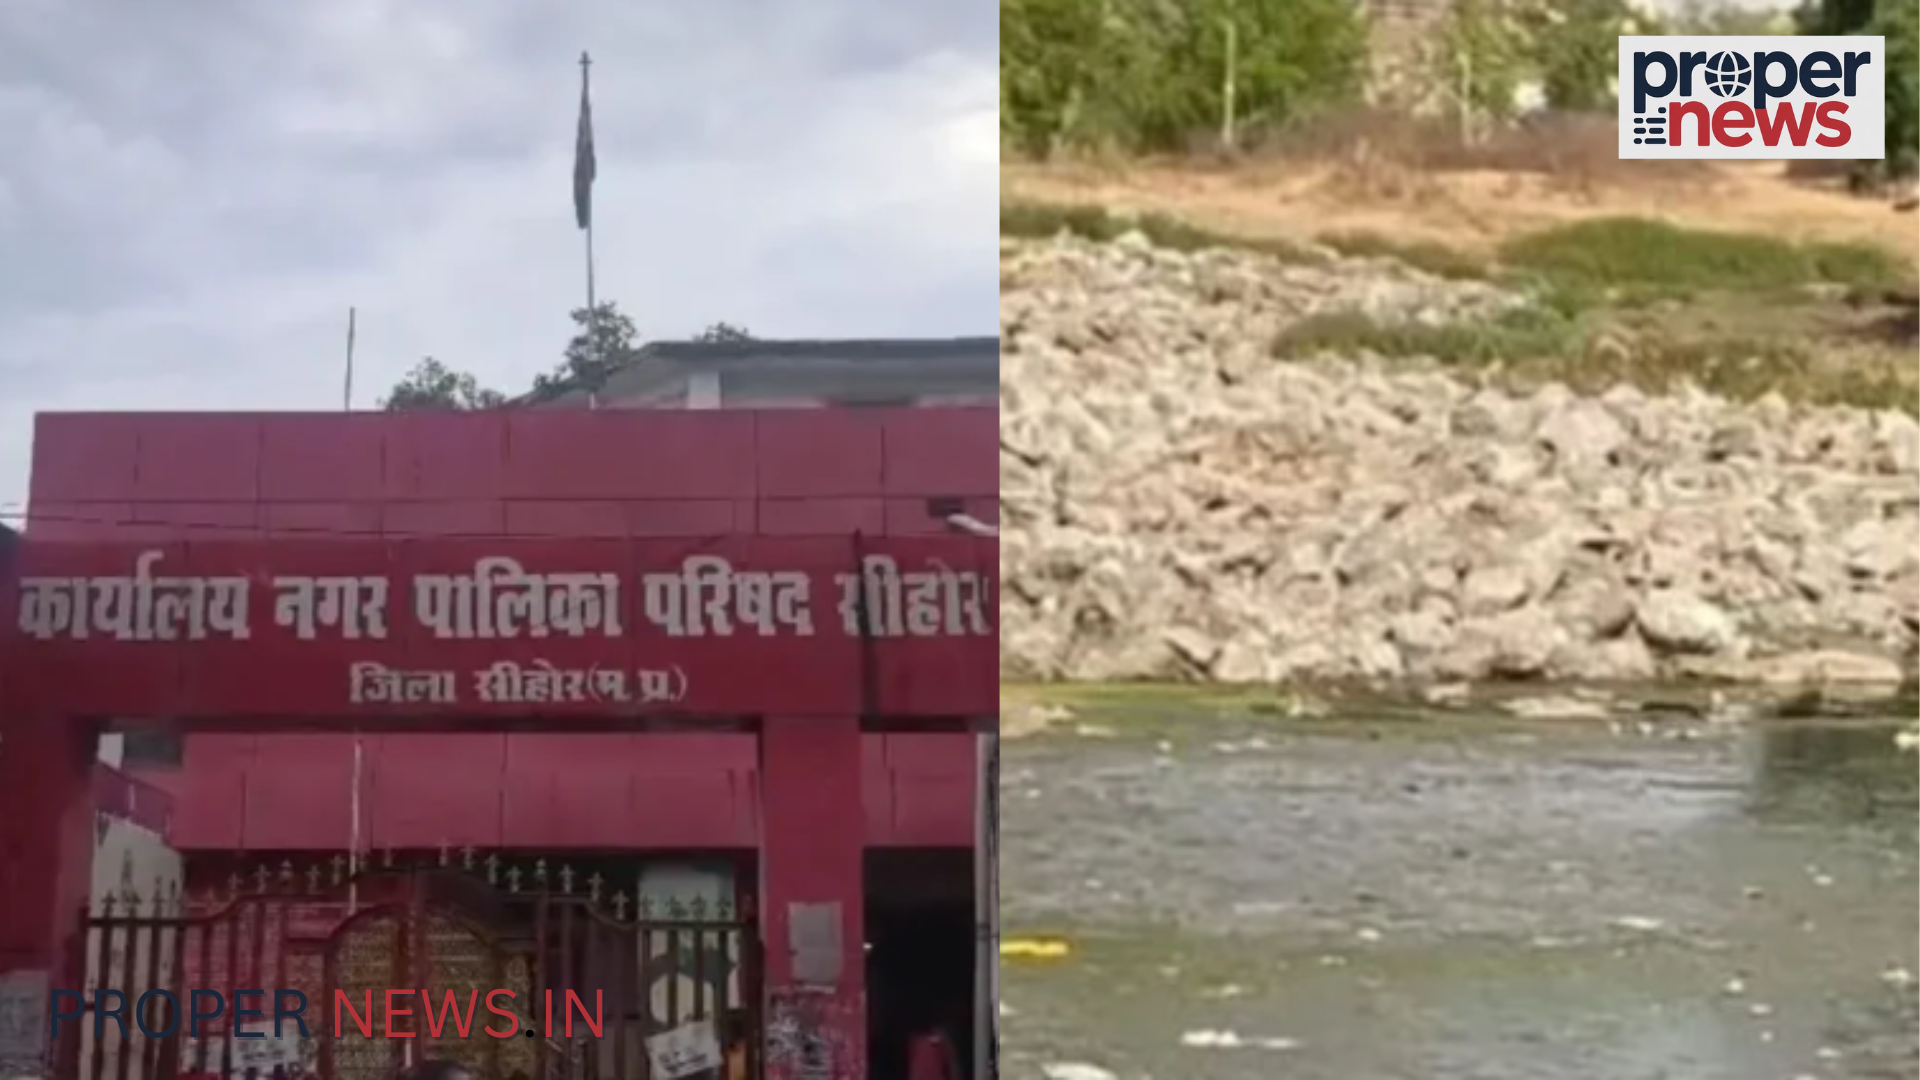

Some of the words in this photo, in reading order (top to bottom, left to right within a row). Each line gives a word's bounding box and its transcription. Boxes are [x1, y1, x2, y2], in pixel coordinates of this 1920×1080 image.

[18, 551, 251, 640] कार्यालय
[273, 575, 388, 640] नगर
[414, 557, 622, 639] पालिका
[643, 555, 815, 637] परिषद
[834, 553, 992, 637] सीहोर
[350, 662, 456, 703] जिला
